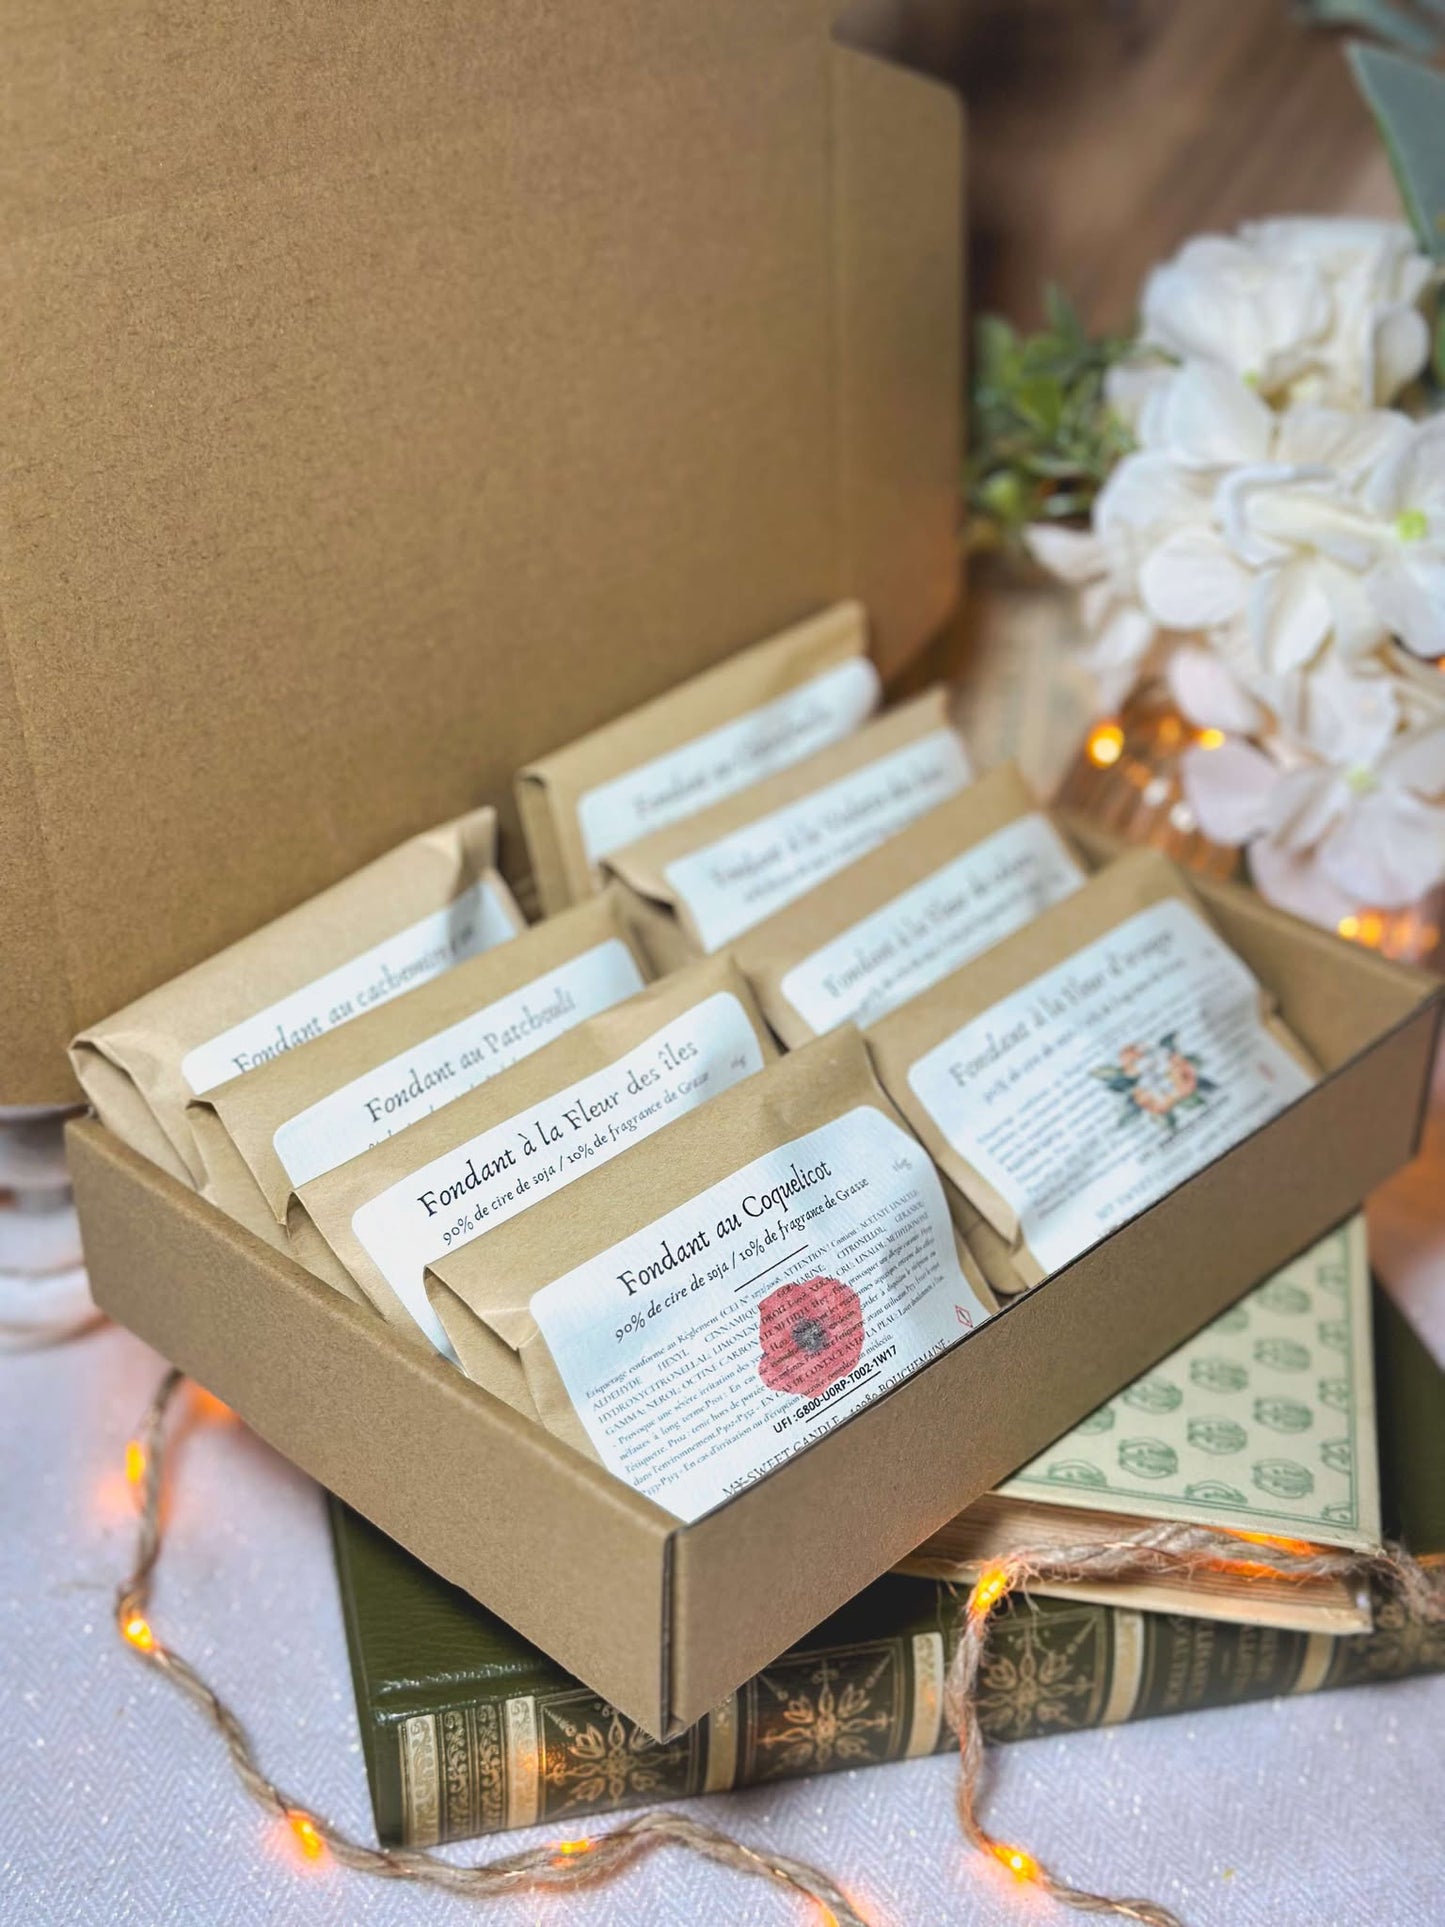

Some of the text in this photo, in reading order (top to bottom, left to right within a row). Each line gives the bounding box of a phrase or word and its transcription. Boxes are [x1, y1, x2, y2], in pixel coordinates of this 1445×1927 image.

[229, 1010, 321, 1072] Fondant
[326, 1000, 354, 1023] au
[362, 1054, 454, 1120] Fondant
[457, 1045, 485, 1069] au
[416, 1039, 698, 1217] Fondant à la Fleur des îles
[442, 1215, 474, 1245] 90%
[473, 1203, 490, 1221] de
[491, 1191, 514, 1210] cire
[515, 1177, 531, 1195] de
[532, 1165, 556, 1185] soja
[566, 1143, 594, 1164] 10%
[593, 1132, 608, 1148] de
[607, 1100, 662, 1142] fragrance
[663, 1089, 678, 1104] de
[616, 1158, 833, 1296] Fondant au Coquelicot
[614, 1312, 646, 1343] 90%
[646, 1299, 662, 1318] de
[664, 1287, 688, 1308] cire
[689, 1273, 705, 1291] de
[706, 1262, 729, 1281] soja
[738, 1238, 765, 1261] 10%
[763, 1228, 778, 1245] de
[776, 1203, 825, 1240] fragrance
[823, 1194, 837, 1209] de
[835, 1178, 869, 1201] Grasse
[627, 1345, 664, 1373] conforme
[784, 1246, 827, 1277] ATTENTION
[712, 1321, 759, 1355] LIMONENE
[592, 1375, 641, 1411] ALDEHYDE
[618, 1417, 656, 1446] Provoque
[657, 1408, 672, 1421] une
[698, 1369, 734, 1396] irritation
[735, 1361, 749, 1373] des
[681, 1362, 718, 1390] OCTINE
[660, 1419, 680, 1436] long
[690, 1417, 710, 1433] tenir
[710, 1405, 728, 1420] hors
[708, 1423, 751, 1455] d'irritation
[746, 1447, 791, 1480] SWEET
[791, 1415, 841, 1450] CANDLE
[773, 1416, 792, 1433] UFI
[632, 1469, 652, 1486] dans
